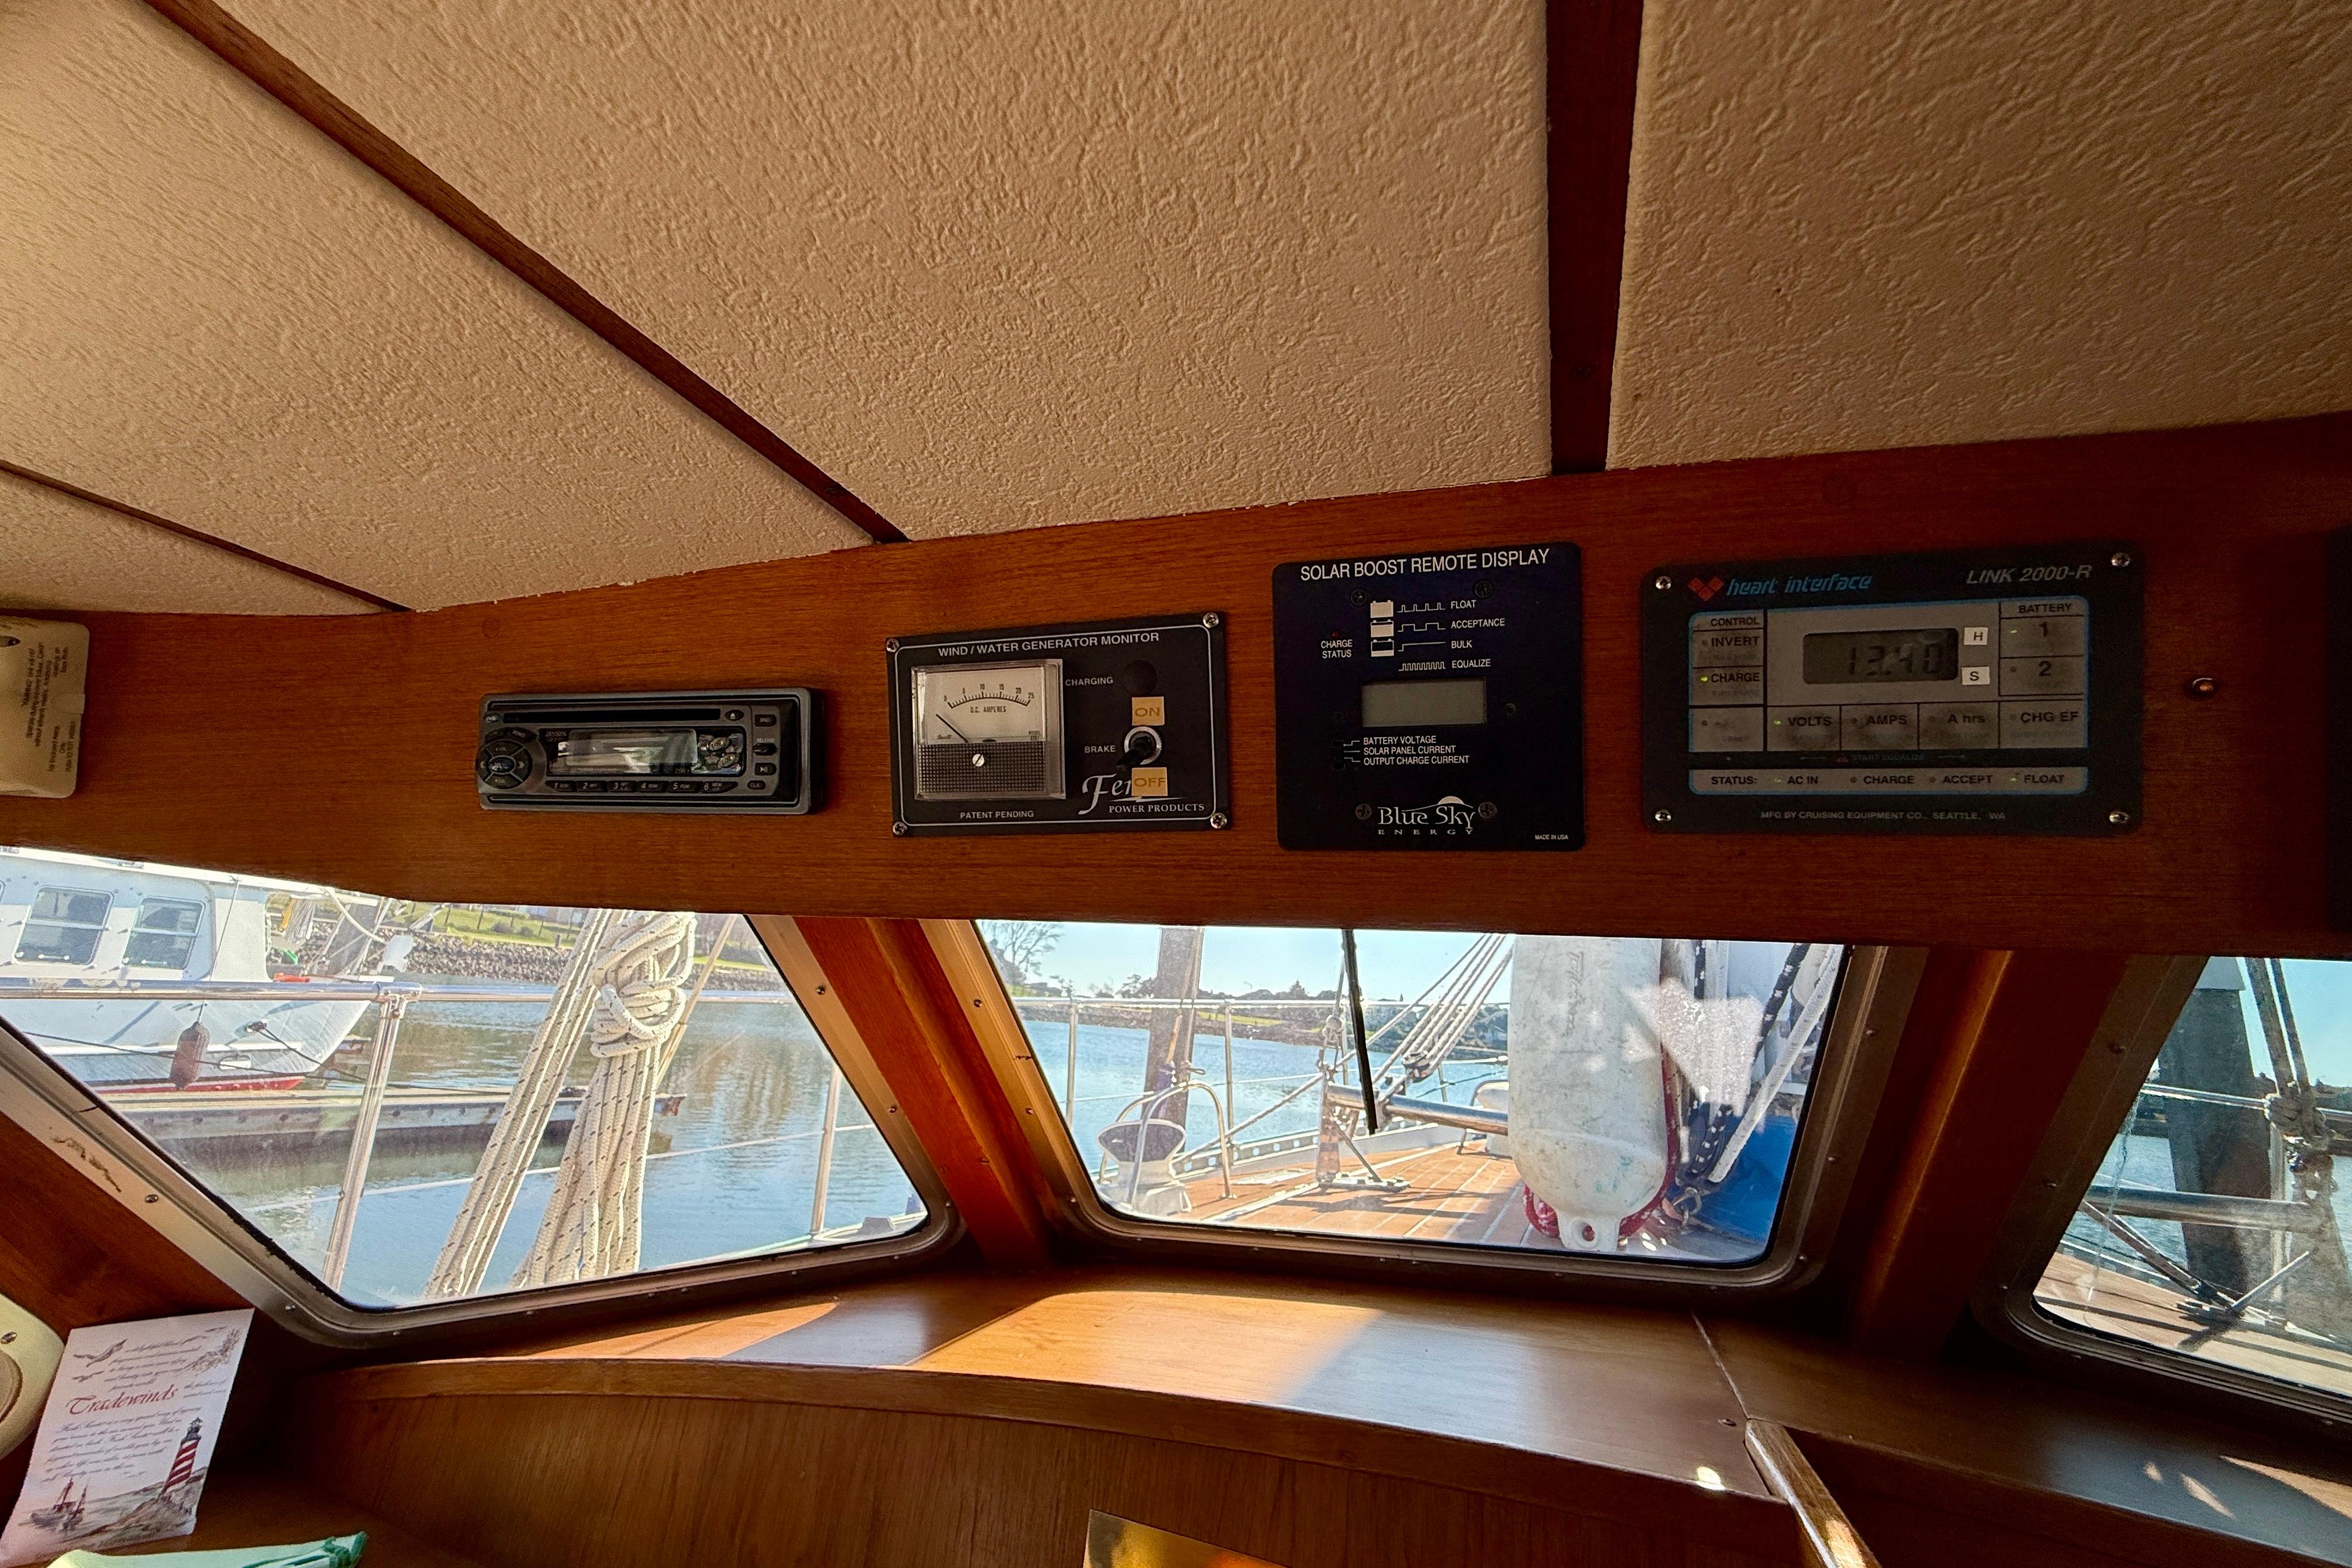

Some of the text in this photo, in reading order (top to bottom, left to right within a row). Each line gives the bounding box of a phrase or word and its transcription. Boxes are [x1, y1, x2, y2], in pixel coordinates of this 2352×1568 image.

[1300, 548, 1550, 581] SOLAR BOOST REMOTE DISPLAY
[1966, 565, 2093, 584] LINK 2000-R
[1727, 573, 1873, 597] heart interface
[1451, 600, 1476, 609] FLOAT
[2019, 603, 2073, 613] BATTERY
[1451, 618, 1505, 629] ACCEPTANCE
[1710, 616, 1760, 626] CONTROL
[2039, 621, 2048, 637] 1
[1711, 636, 1760, 646] INVERT
[1973, 631, 1983, 641] H
[938, 632, 1159, 656] WIND / WATER GENERATOR MONITOR
[1321, 639, 1353, 649] CHARGE
[1451, 640, 1472, 649] BULK
[1322, 649, 1352, 659] STATUS
[1451, 659, 1491, 668] EQUALIZE
[2038, 660, 2052, 677] 2
[1711, 673, 1760, 682] CHARGE
[1969, 671, 1979, 681] S
[1065, 677, 1114, 687] CHARGING
[1135, 707, 1160, 717] ON
[2020, 711, 2079, 723] CHG EF
[1787, 716, 1833, 727] VOLTS
[1866, 715, 1908, 725] AMPS
[1947, 713, 1986, 724] A hrs
[1363, 736, 1437, 745] BATTERY VOLTAGE
[1084, 745, 1116, 753] BRAKE
[1363, 745, 1457, 755] SOLAR PANEL CURRENT
[1363, 755, 1470, 765] OUTPUT CHARGE CURRENT
[1133, 777, 1166, 788] OFF
[1711, 776, 1757, 785] STATUS:
[1787, 776, 1819, 785] AC IN
[1863, 775, 1915, 784] CHARGE
[1942, 775, 1993, 784] ACCEPT
[2024, 774, 2065, 783] FLOAT
[1109, 803, 1205, 813] POWER PRODUCTS
[1377, 806, 1476, 829] Blue Sky
[1798, 811, 1845, 819] CRUISING
[66, 1384, 178, 1416] Tradewinds
